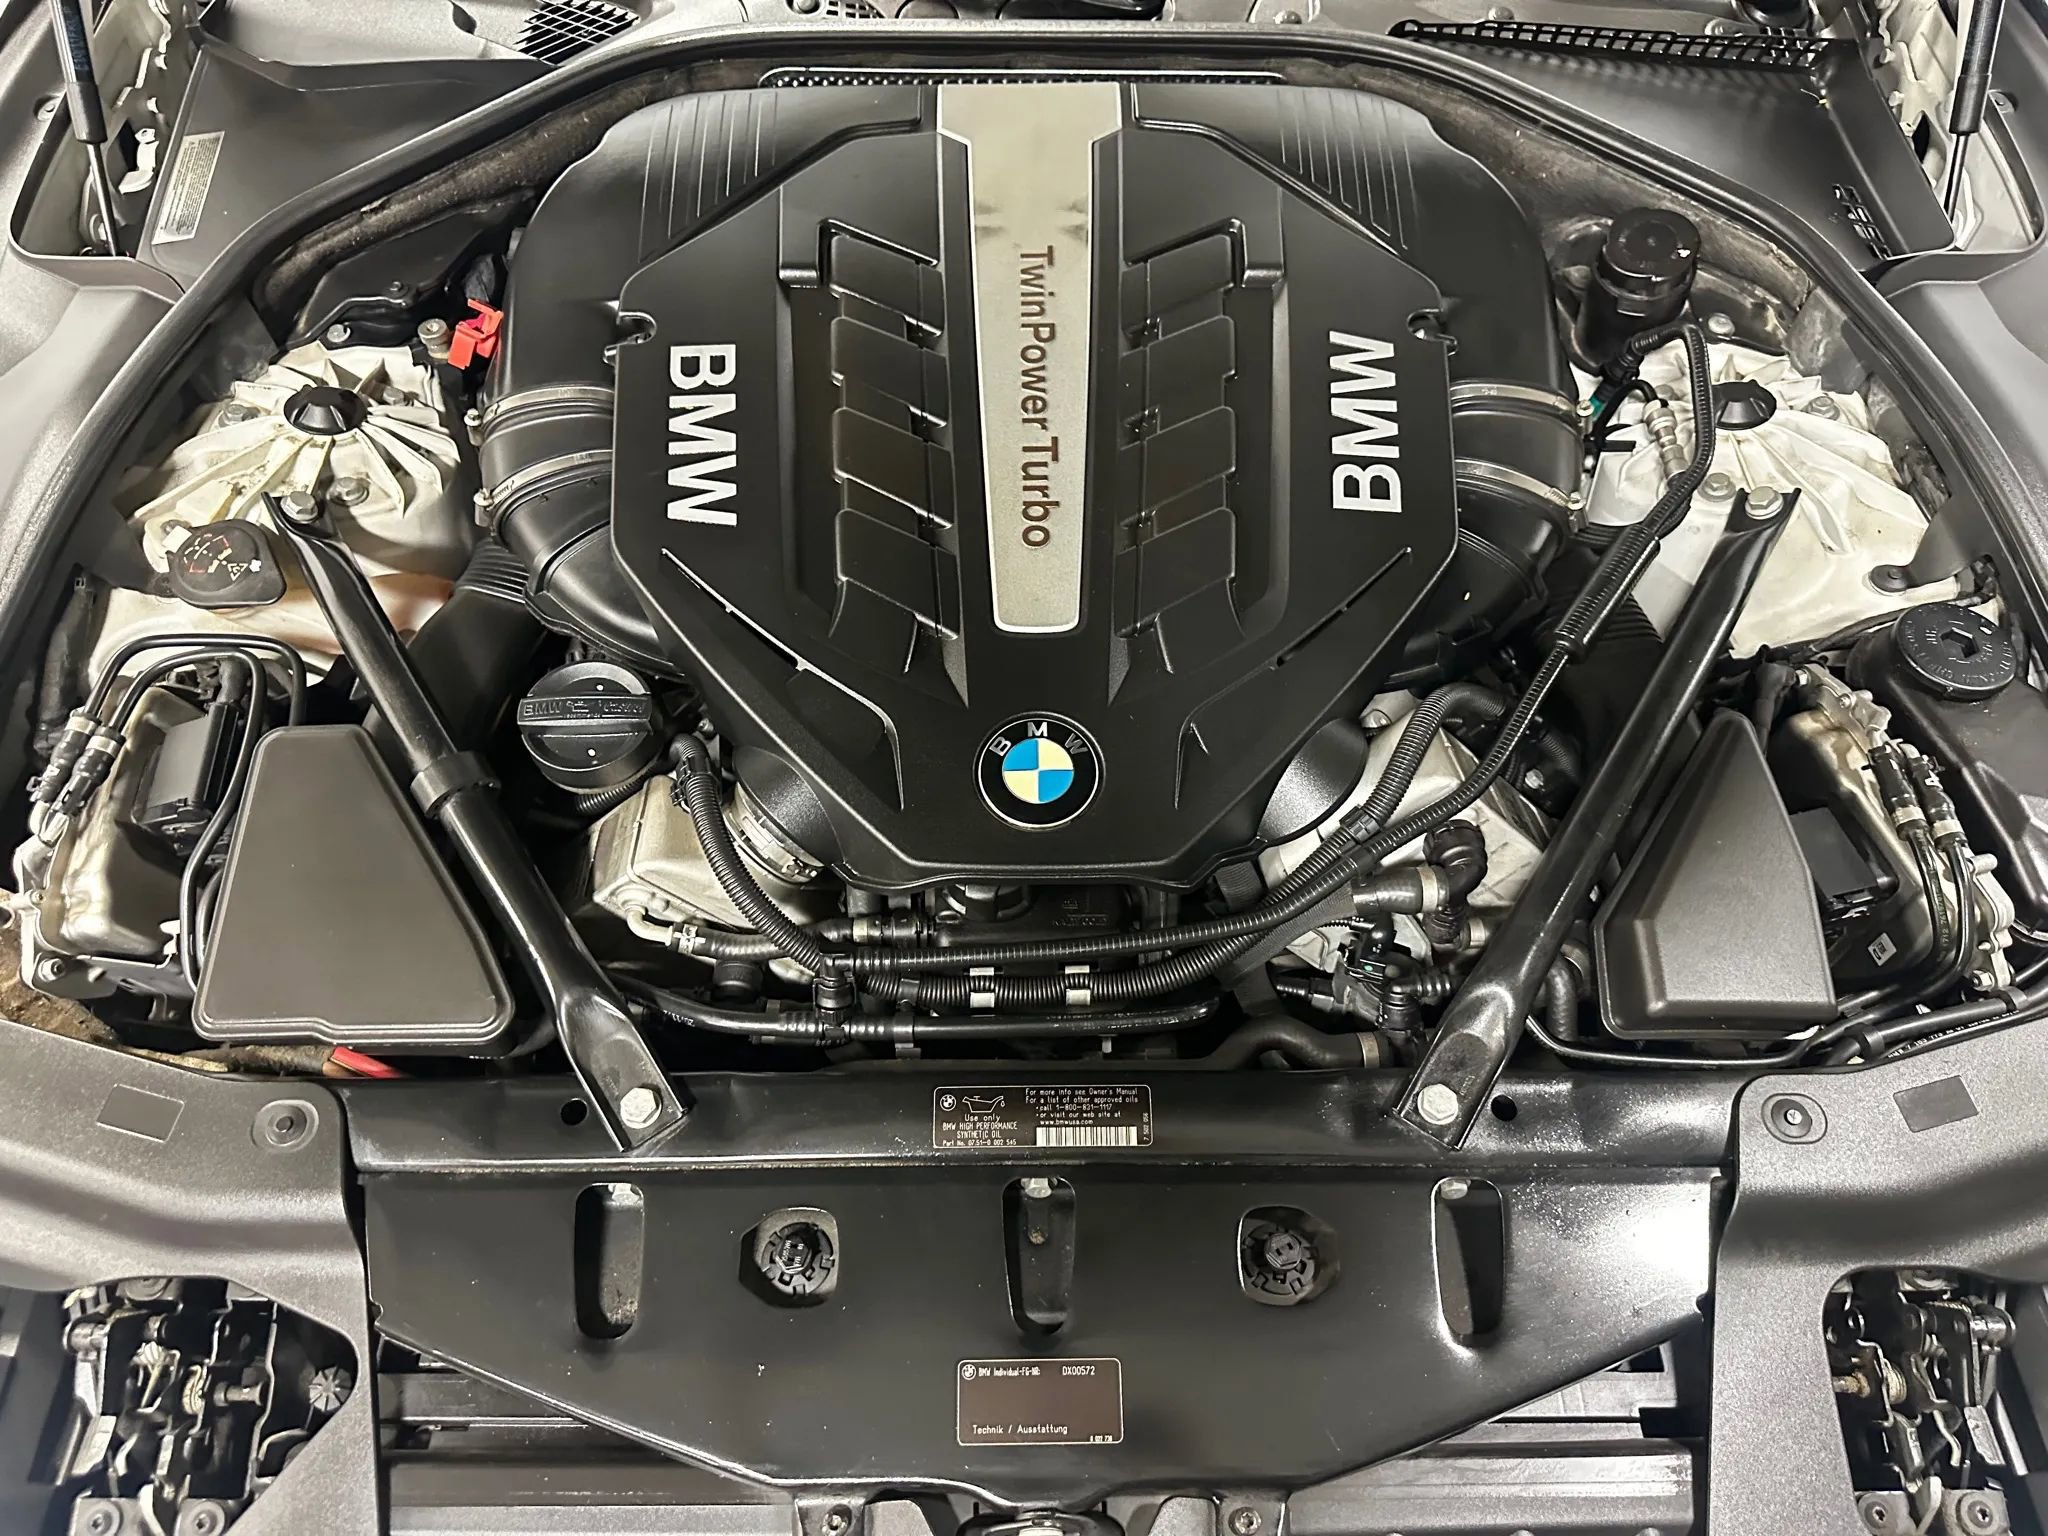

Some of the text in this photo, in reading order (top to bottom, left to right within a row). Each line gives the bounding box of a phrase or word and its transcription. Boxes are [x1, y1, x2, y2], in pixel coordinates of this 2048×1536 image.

[1019, 245, 1060, 548] TwinPower Turbo
[1329, 331, 1402, 513] BMW
[667, 344, 737, 527] BMW
[524, 701, 562, 716] BMW
[989, 721, 1088, 757] BMW
[1025, 1087, 1036, 1095] For
[1089, 1087, 1113, 1095] Owner's
[1116, 1087, 1138, 1095] Manual
[1025, 1096, 1036, 1104] For
[1093, 1096, 1122, 1105] approved
[983, 1113, 1001, 1123] only
[942, 1121, 1018, 1131] BMW HIGH PERFORMANCE
[956, 1130, 1002, 1139] SYNTHETIC OIL
[978, 1367, 991, 1377] BMW
[972, 1424, 1004, 1435] Technik
[1017, 1423, 1068, 1435] Ausstattung
